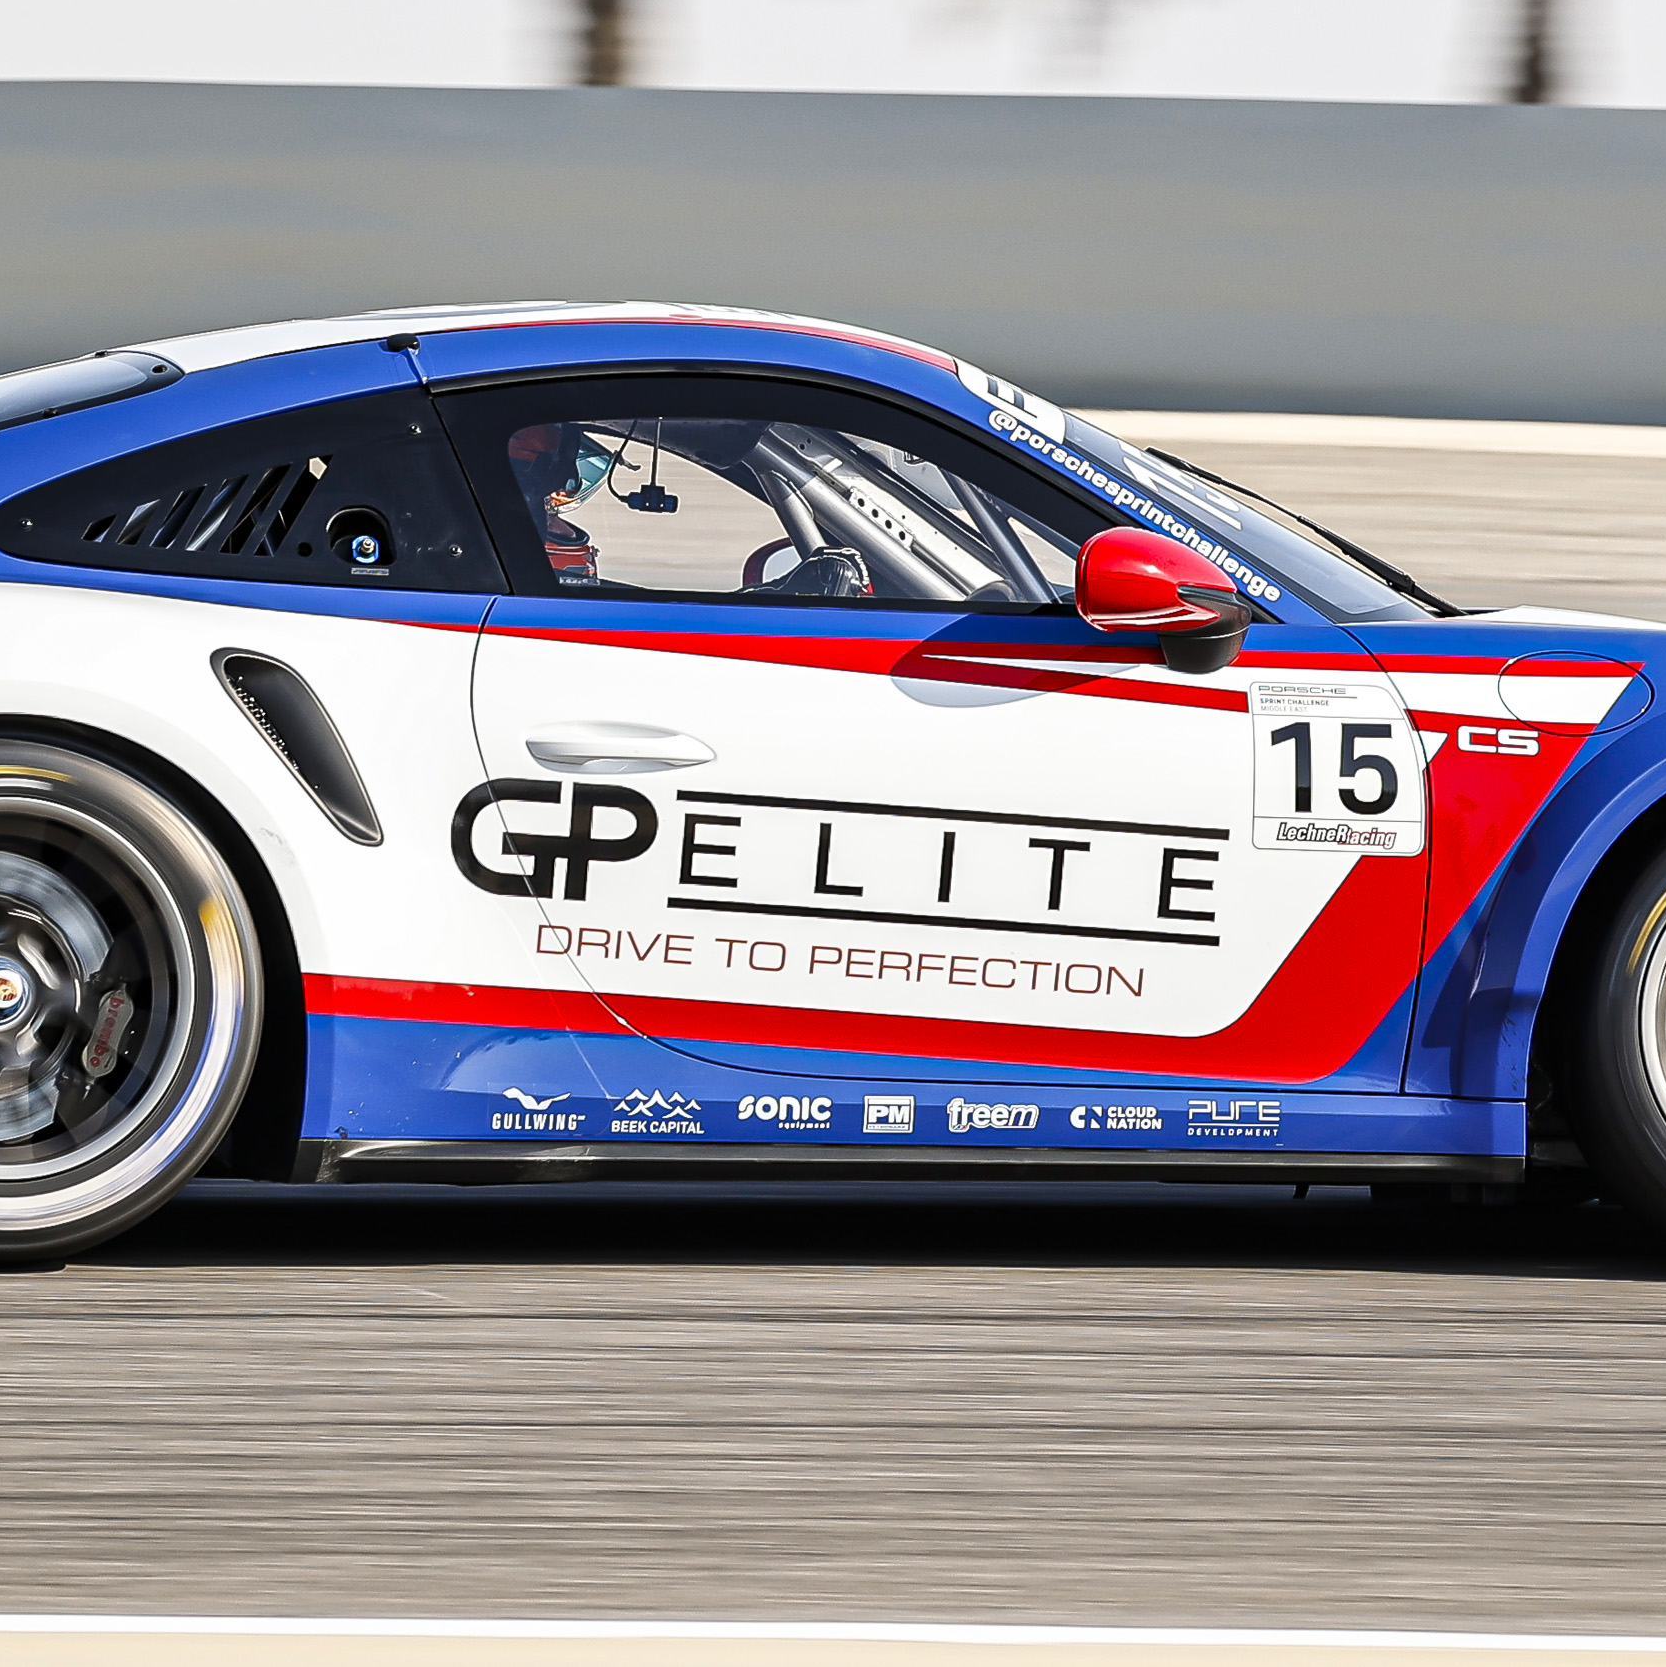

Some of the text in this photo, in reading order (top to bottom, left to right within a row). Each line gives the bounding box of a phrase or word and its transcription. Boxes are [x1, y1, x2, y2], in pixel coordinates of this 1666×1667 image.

[988, 409, 1281, 602] @porschesprintchallenge
[1258, 685, 1347, 695] PORSCHE
[1259, 697, 1330, 707] SPRINT CHALLENGE
[1456, 725, 1541, 756] CS
[1271, 722, 1399, 815] 15
[678, 812, 1221, 923] ELITE
[535, 924, 1146, 998] DRIVE TO PERFECTION
[90, 997, 125, 1068] brembo
[737, 1095, 833, 1121] SONIC
[867, 1105, 910, 1124] PM
[948, 1098, 1039, 1131] freem
[1107, 1106, 1158, 1119] CLOUD
[491, 1113, 579, 1131] GULLWING
[610, 1120, 705, 1135] BEEK CAPITAL
[1106, 1118, 1163, 1130] NATION
[1187, 1127, 1279, 1137] DEVELOPMENT
